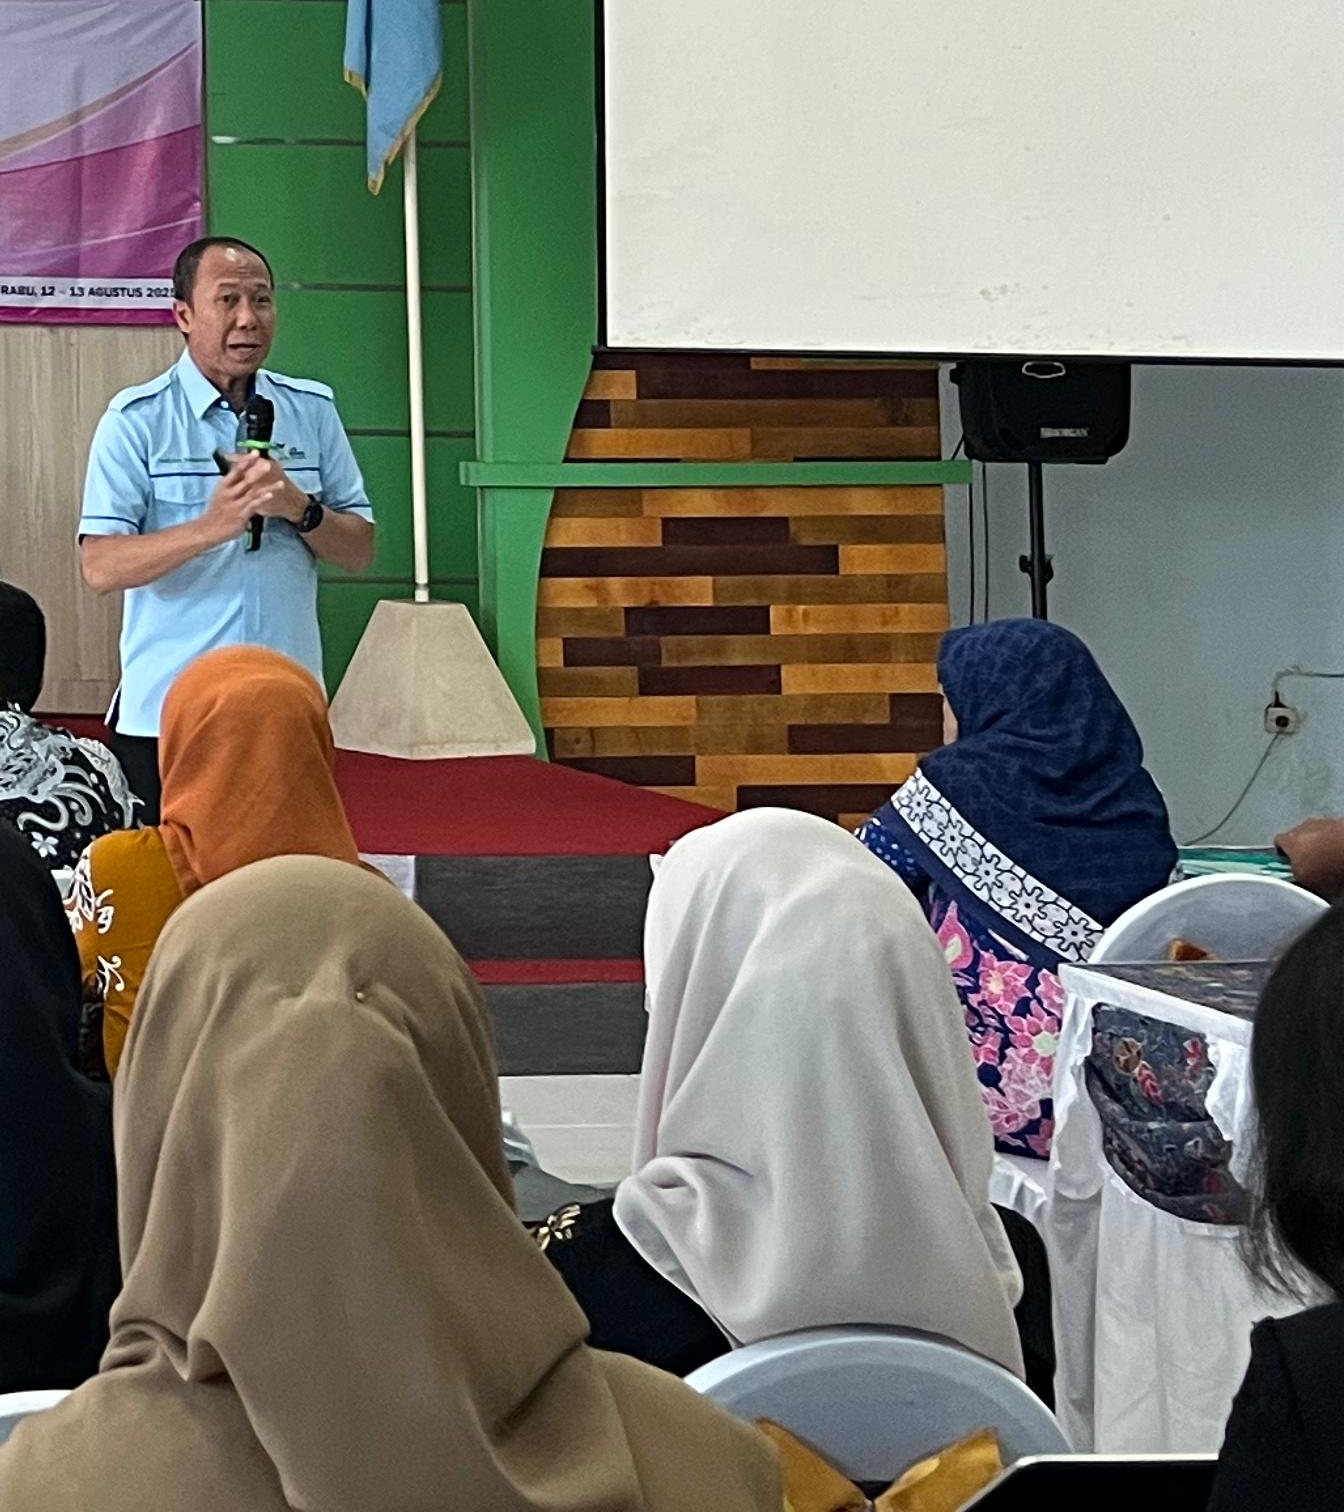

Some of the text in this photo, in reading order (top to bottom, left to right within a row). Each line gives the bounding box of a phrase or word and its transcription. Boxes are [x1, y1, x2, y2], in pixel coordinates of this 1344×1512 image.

[40, 285, 56, 296] 12
[69, 286, 85, 297] 13
[87, 287, 143, 298] AGUSTUS
